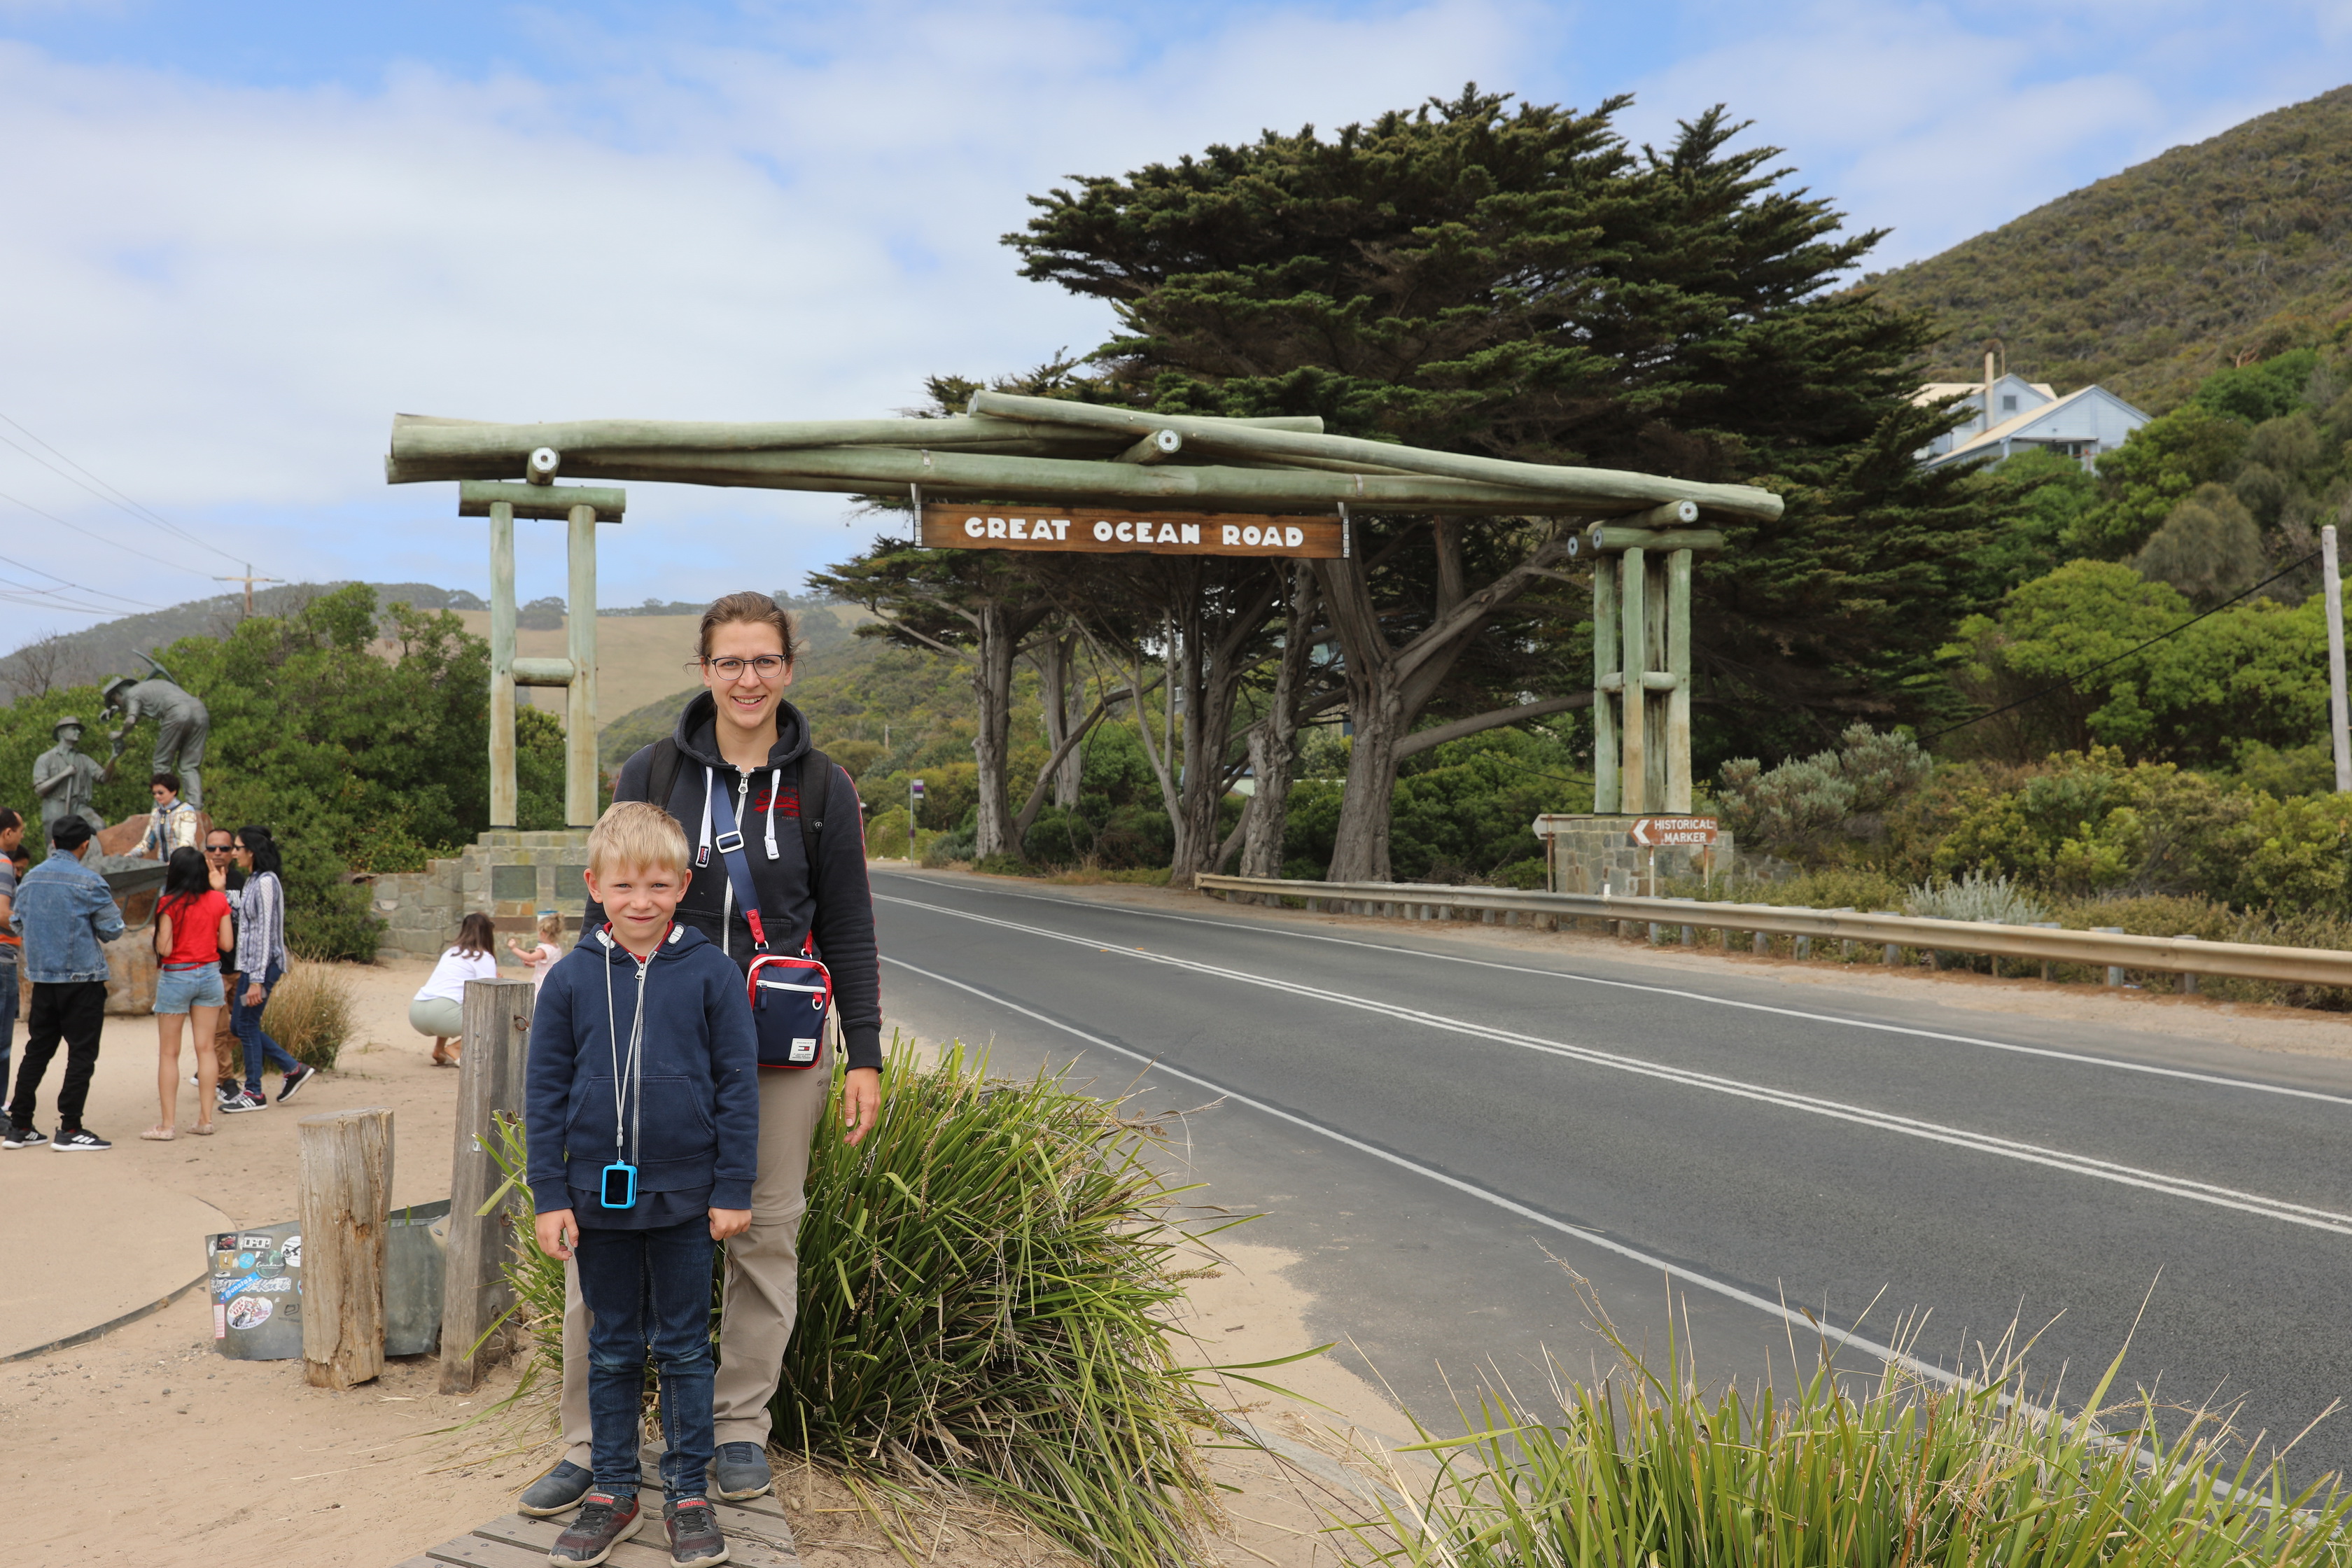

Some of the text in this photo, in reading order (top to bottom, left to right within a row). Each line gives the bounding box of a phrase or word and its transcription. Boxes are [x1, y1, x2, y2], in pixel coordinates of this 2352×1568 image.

[965, 517, 1304, 547] GREAT OCEAN ROAD
[1654, 819, 1714, 830] HISTORICAL
[1664, 832, 1707, 843] MARKER
